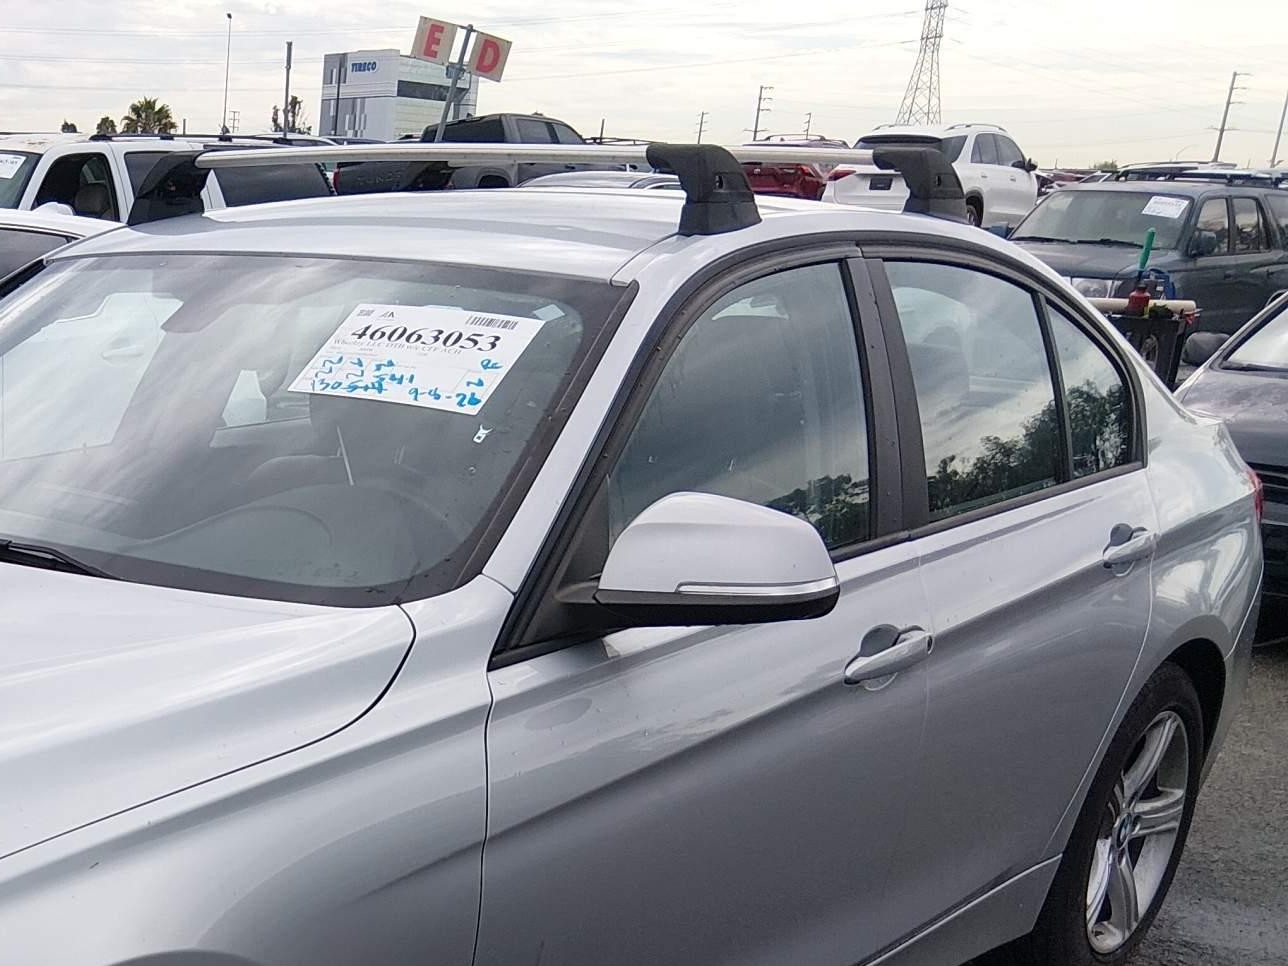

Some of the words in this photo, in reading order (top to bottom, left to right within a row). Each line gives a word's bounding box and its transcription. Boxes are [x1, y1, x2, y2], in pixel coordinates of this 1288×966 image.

[423, 23, 445, 58] E
[475, 39, 501, 73] D
[351, 324, 502, 351] 46063053
